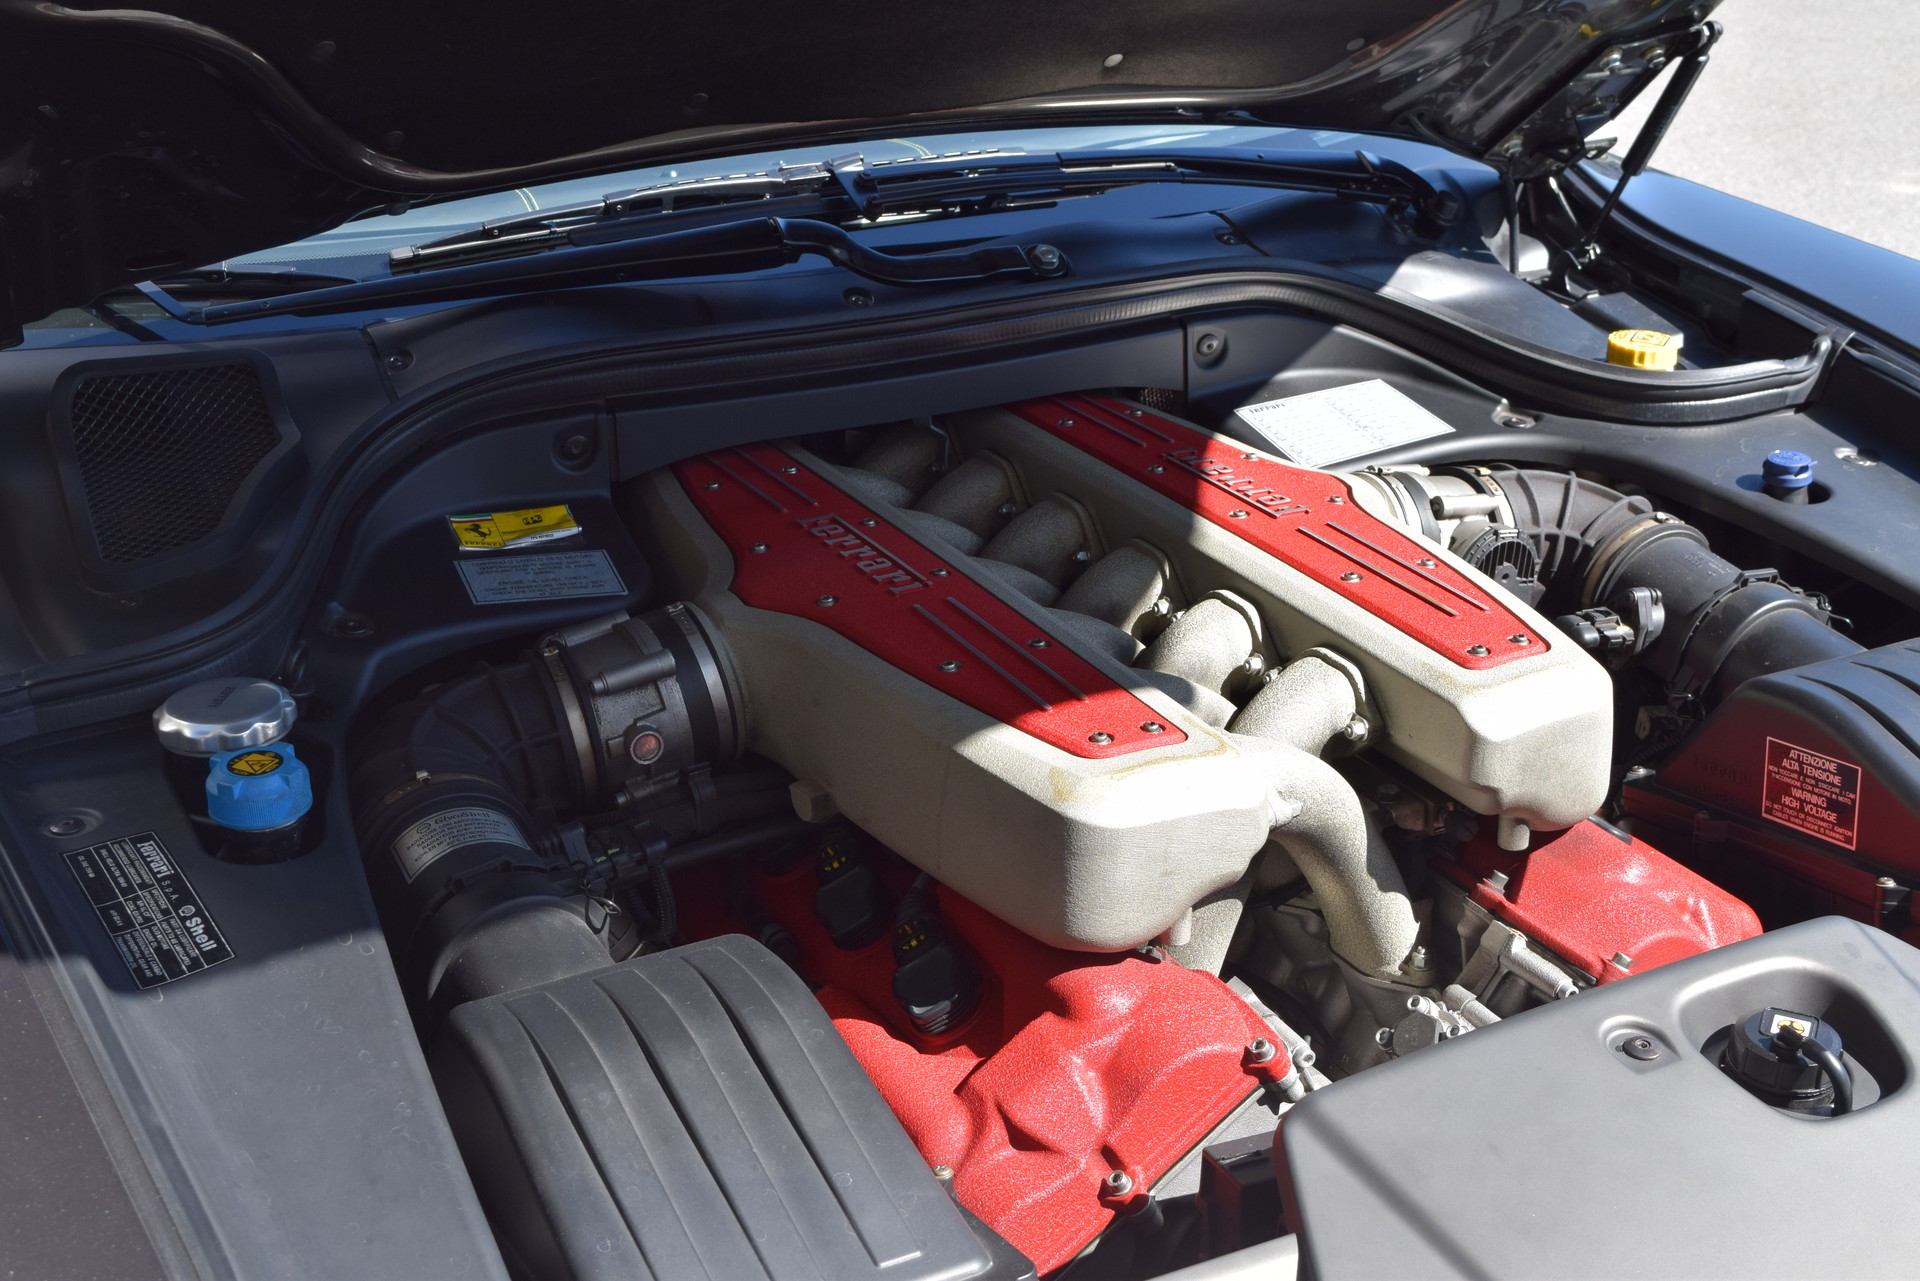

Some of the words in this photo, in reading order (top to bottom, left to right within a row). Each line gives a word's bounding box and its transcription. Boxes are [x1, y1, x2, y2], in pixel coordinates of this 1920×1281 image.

[1160, 448, 1311, 519] Ferrari
[522, 514, 543, 525] PPG
[796, 512, 933, 596] Ferrari
[1781, 757, 1799, 771] ALTA
[1802, 764, 1841, 786] TENSIONE
[1789, 748, 1837, 773] ATTENZIONE
[1768, 764, 1777, 772] NON
[1778, 767, 1798, 779] TOCCARE
[1805, 777, 1815, 785] NON
[1817, 781, 1839, 793] STACCARE
[1802, 782, 1812, 791] CON
[1813, 786, 1830, 797] MOTORE
[1781, 794, 1799, 809] HIGH
[1803, 802, 1837, 823] VOLTAGE
[1791, 786, 1826, 807] WARNING
[434, 811, 490, 824] GlycoShell
[1773, 803, 1781, 811] NOT
[1782, 806, 1797, 816] TOUCH
[1834, 825, 1852, 837] IGNITION
[406, 827, 437, 851] RADIATORE
[438, 822, 452, 830] CON
[416, 828, 446, 848] RADIATOR
[421, 831, 455, 850] RADIATEUR
[138, 840, 175, 878] Ferrari
[186, 916, 217, 951] Shell
[141, 891, 164, 919] SPECIFICATIONS
